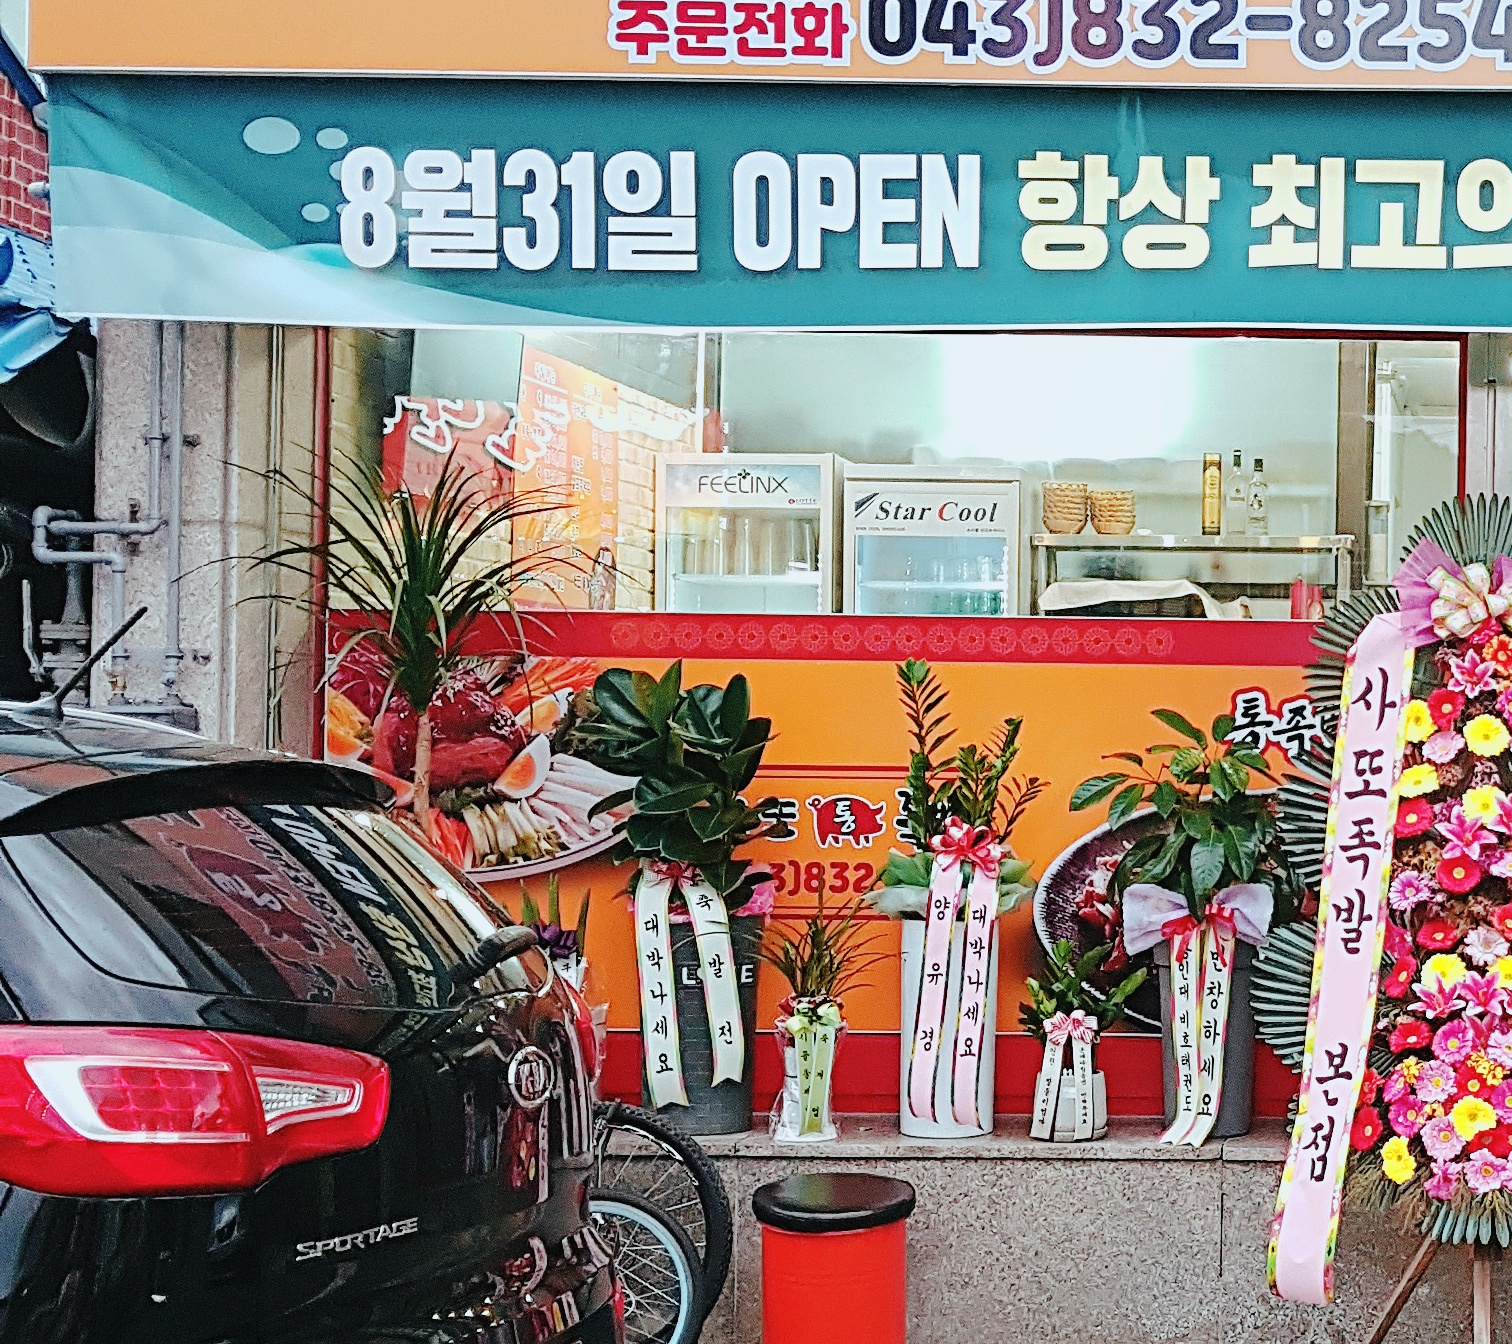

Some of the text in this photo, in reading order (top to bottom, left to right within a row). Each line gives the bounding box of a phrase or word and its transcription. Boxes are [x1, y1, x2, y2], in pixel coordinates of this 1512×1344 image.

[338, 147, 699, 273] 8월31일
[731, 150, 982, 272] OPEN
[1016, 151, 1221, 270] 항상
[697, 472, 789, 494] FEELINX
[874, 500, 999, 523] Star Cool
[643, 913, 674, 1075] 대박나세요
[919, 895, 951, 1052] 양유경
[958, 903, 987, 1058] 대박나세요
[1301, 666, 1397, 1183] 사또족발 본점
[295, 1216, 419, 1262] SPORTAGE
